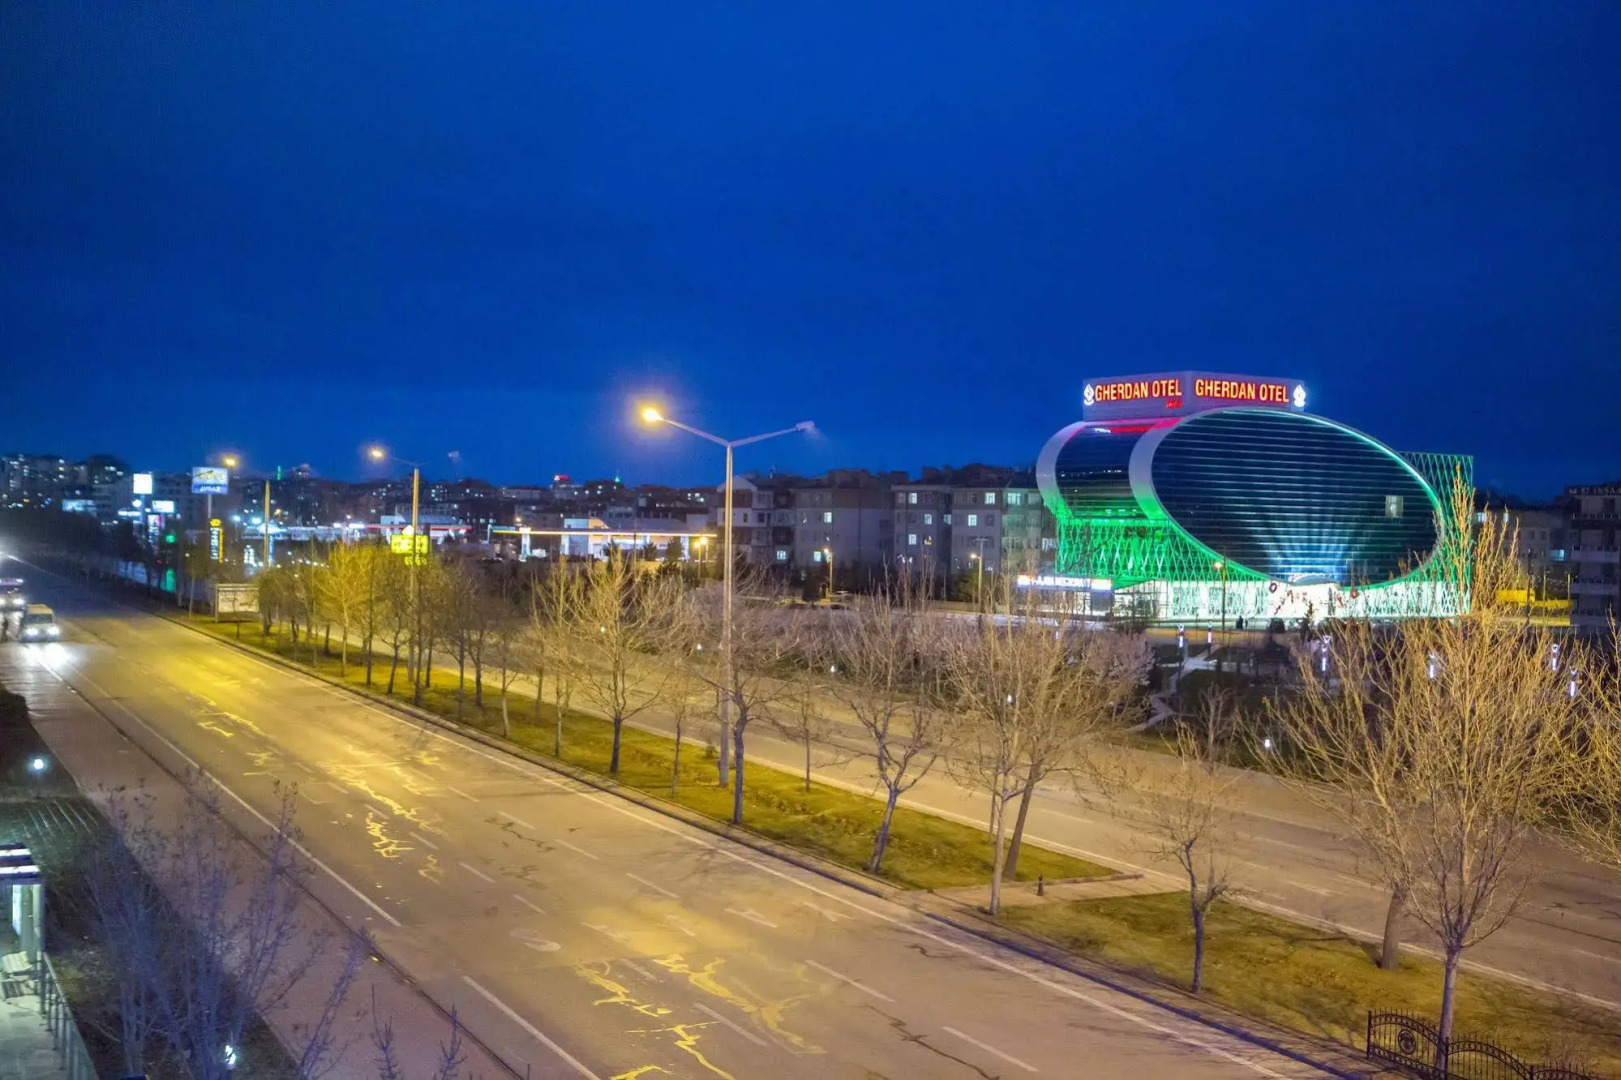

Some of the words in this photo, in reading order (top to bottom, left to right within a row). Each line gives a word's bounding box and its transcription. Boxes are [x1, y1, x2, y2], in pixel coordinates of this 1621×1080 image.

[1094, 381, 1149, 401] GHERDAN
[1152, 379, 1182, 397] OTEL
[1195, 378, 1256, 400] GHERDAN
[1259, 383, 1290, 402] OTEL
